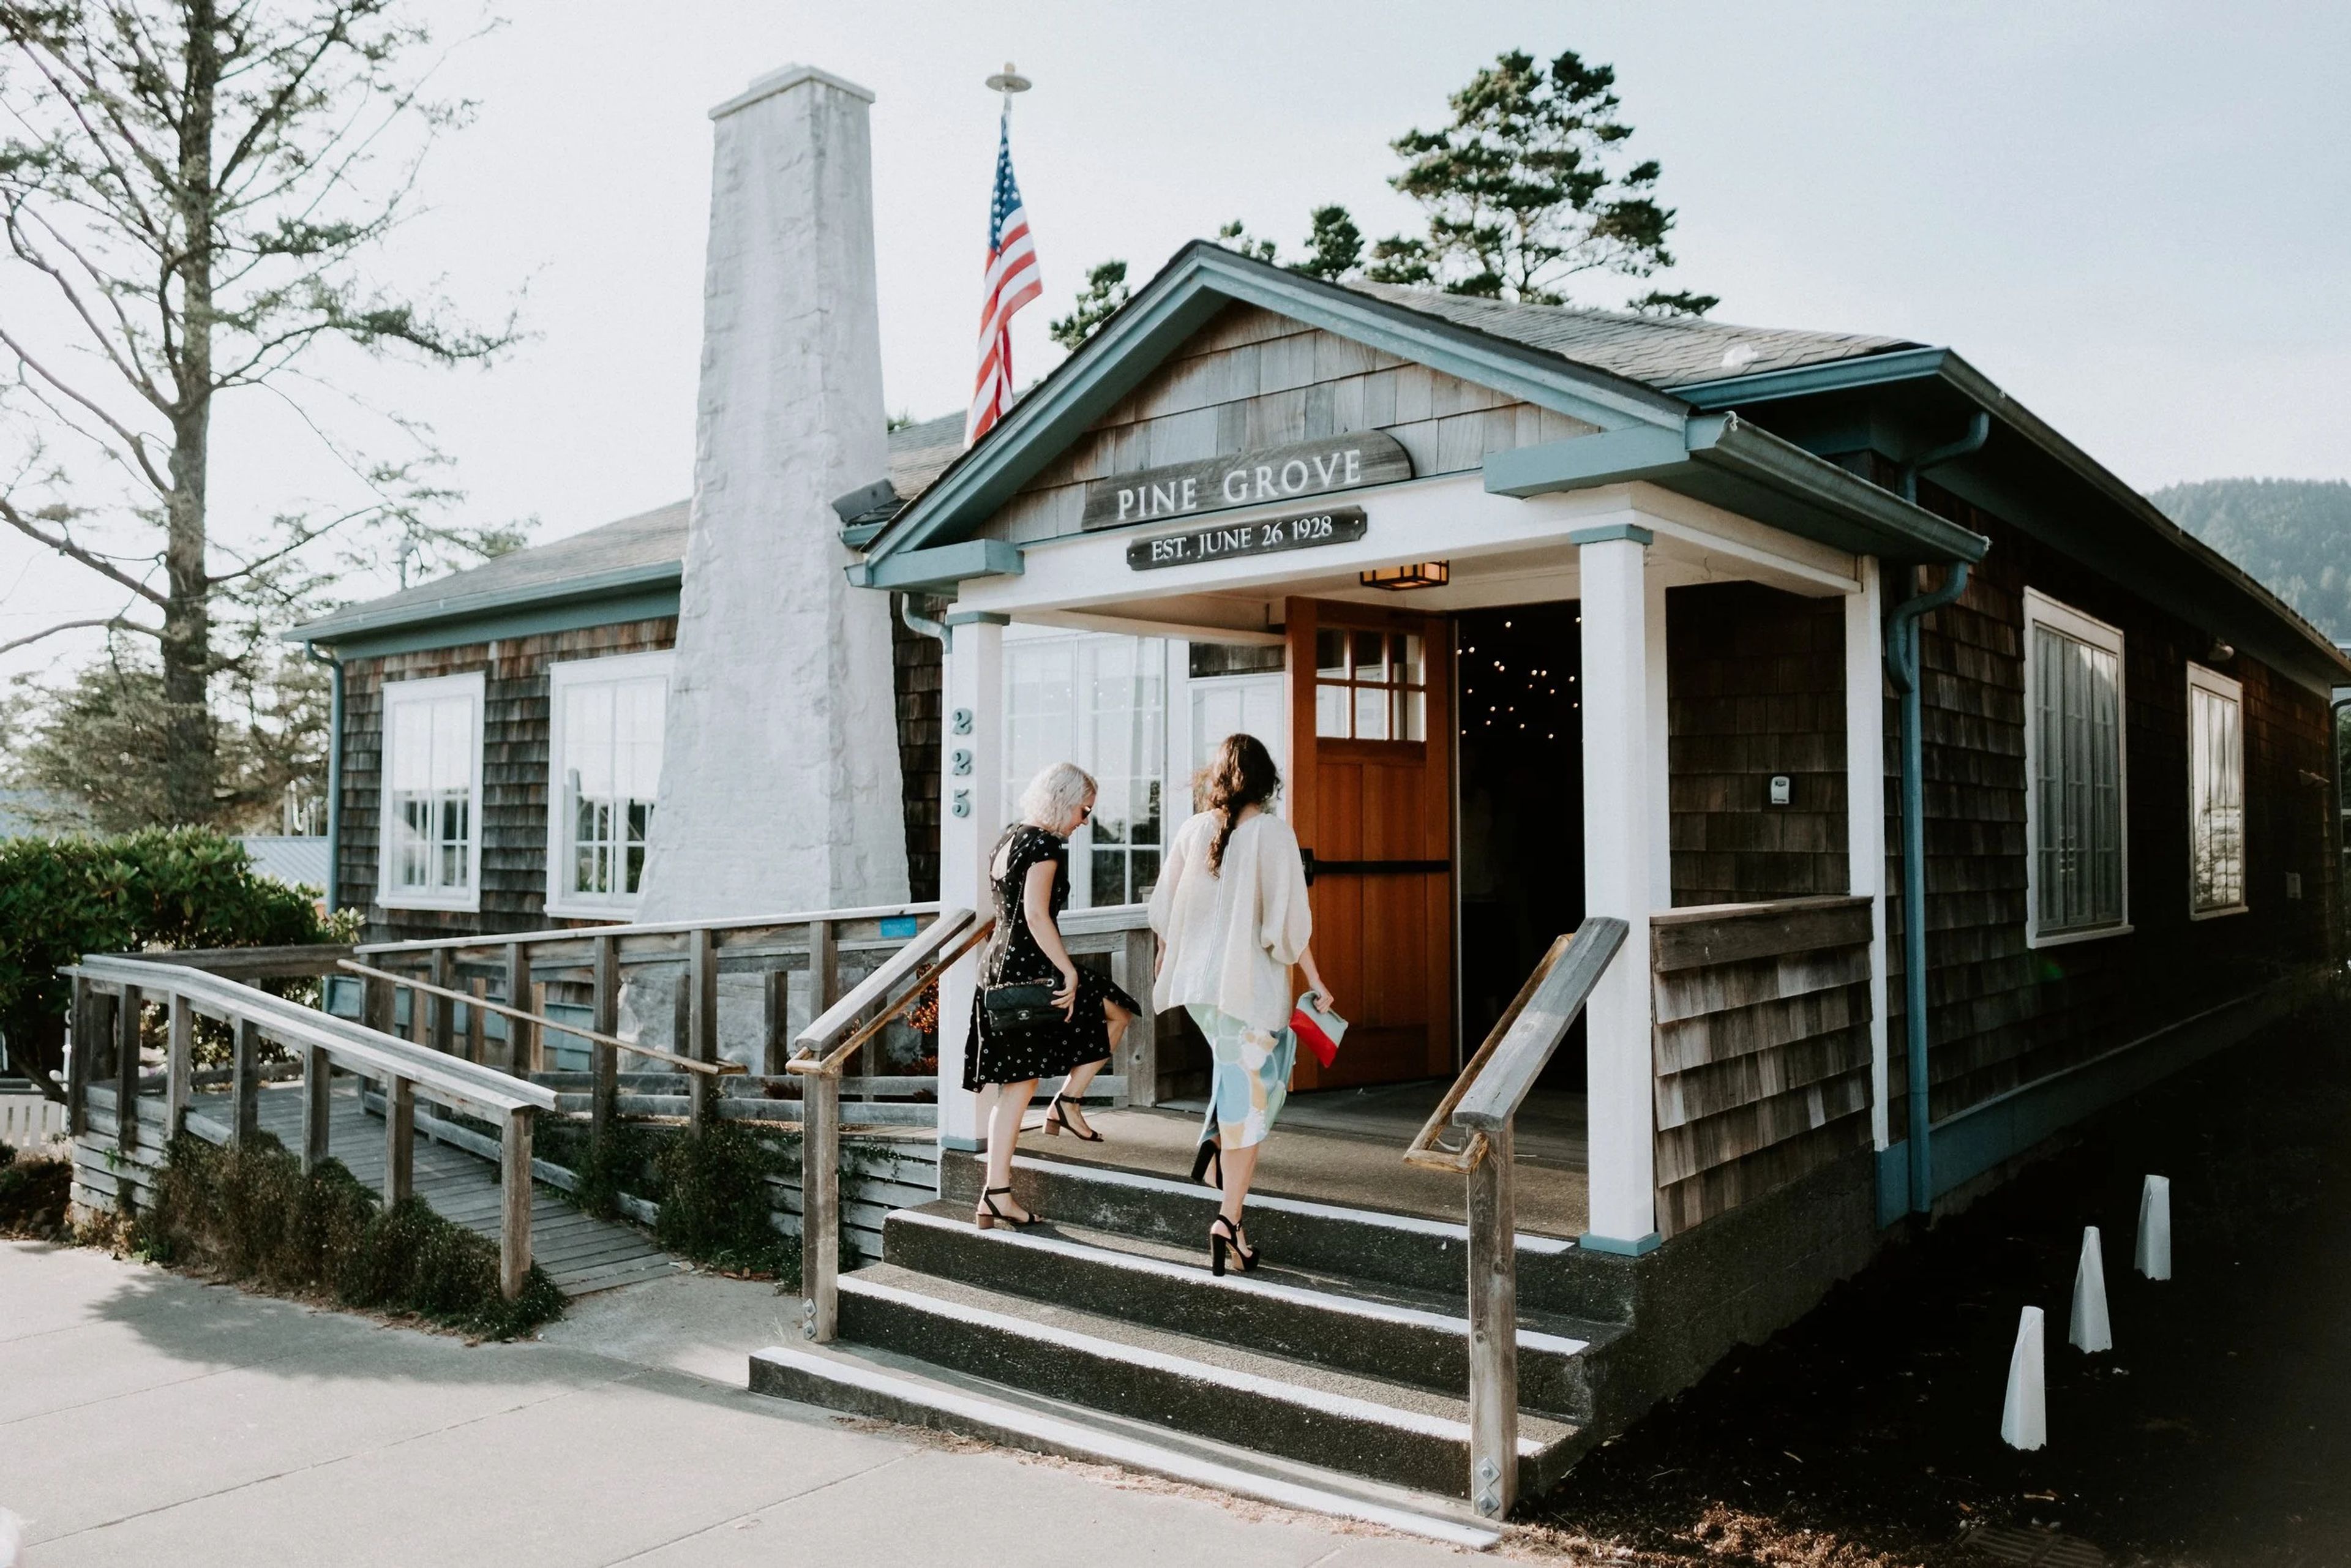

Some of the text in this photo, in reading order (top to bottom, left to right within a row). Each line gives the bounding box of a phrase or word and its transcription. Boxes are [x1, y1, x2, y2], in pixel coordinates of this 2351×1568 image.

[1117, 448, 1362, 521] PINE GROVE
[1151, 515, 1333, 562] EST. JUNE 26 1928
[951, 707, 973, 819] 225
